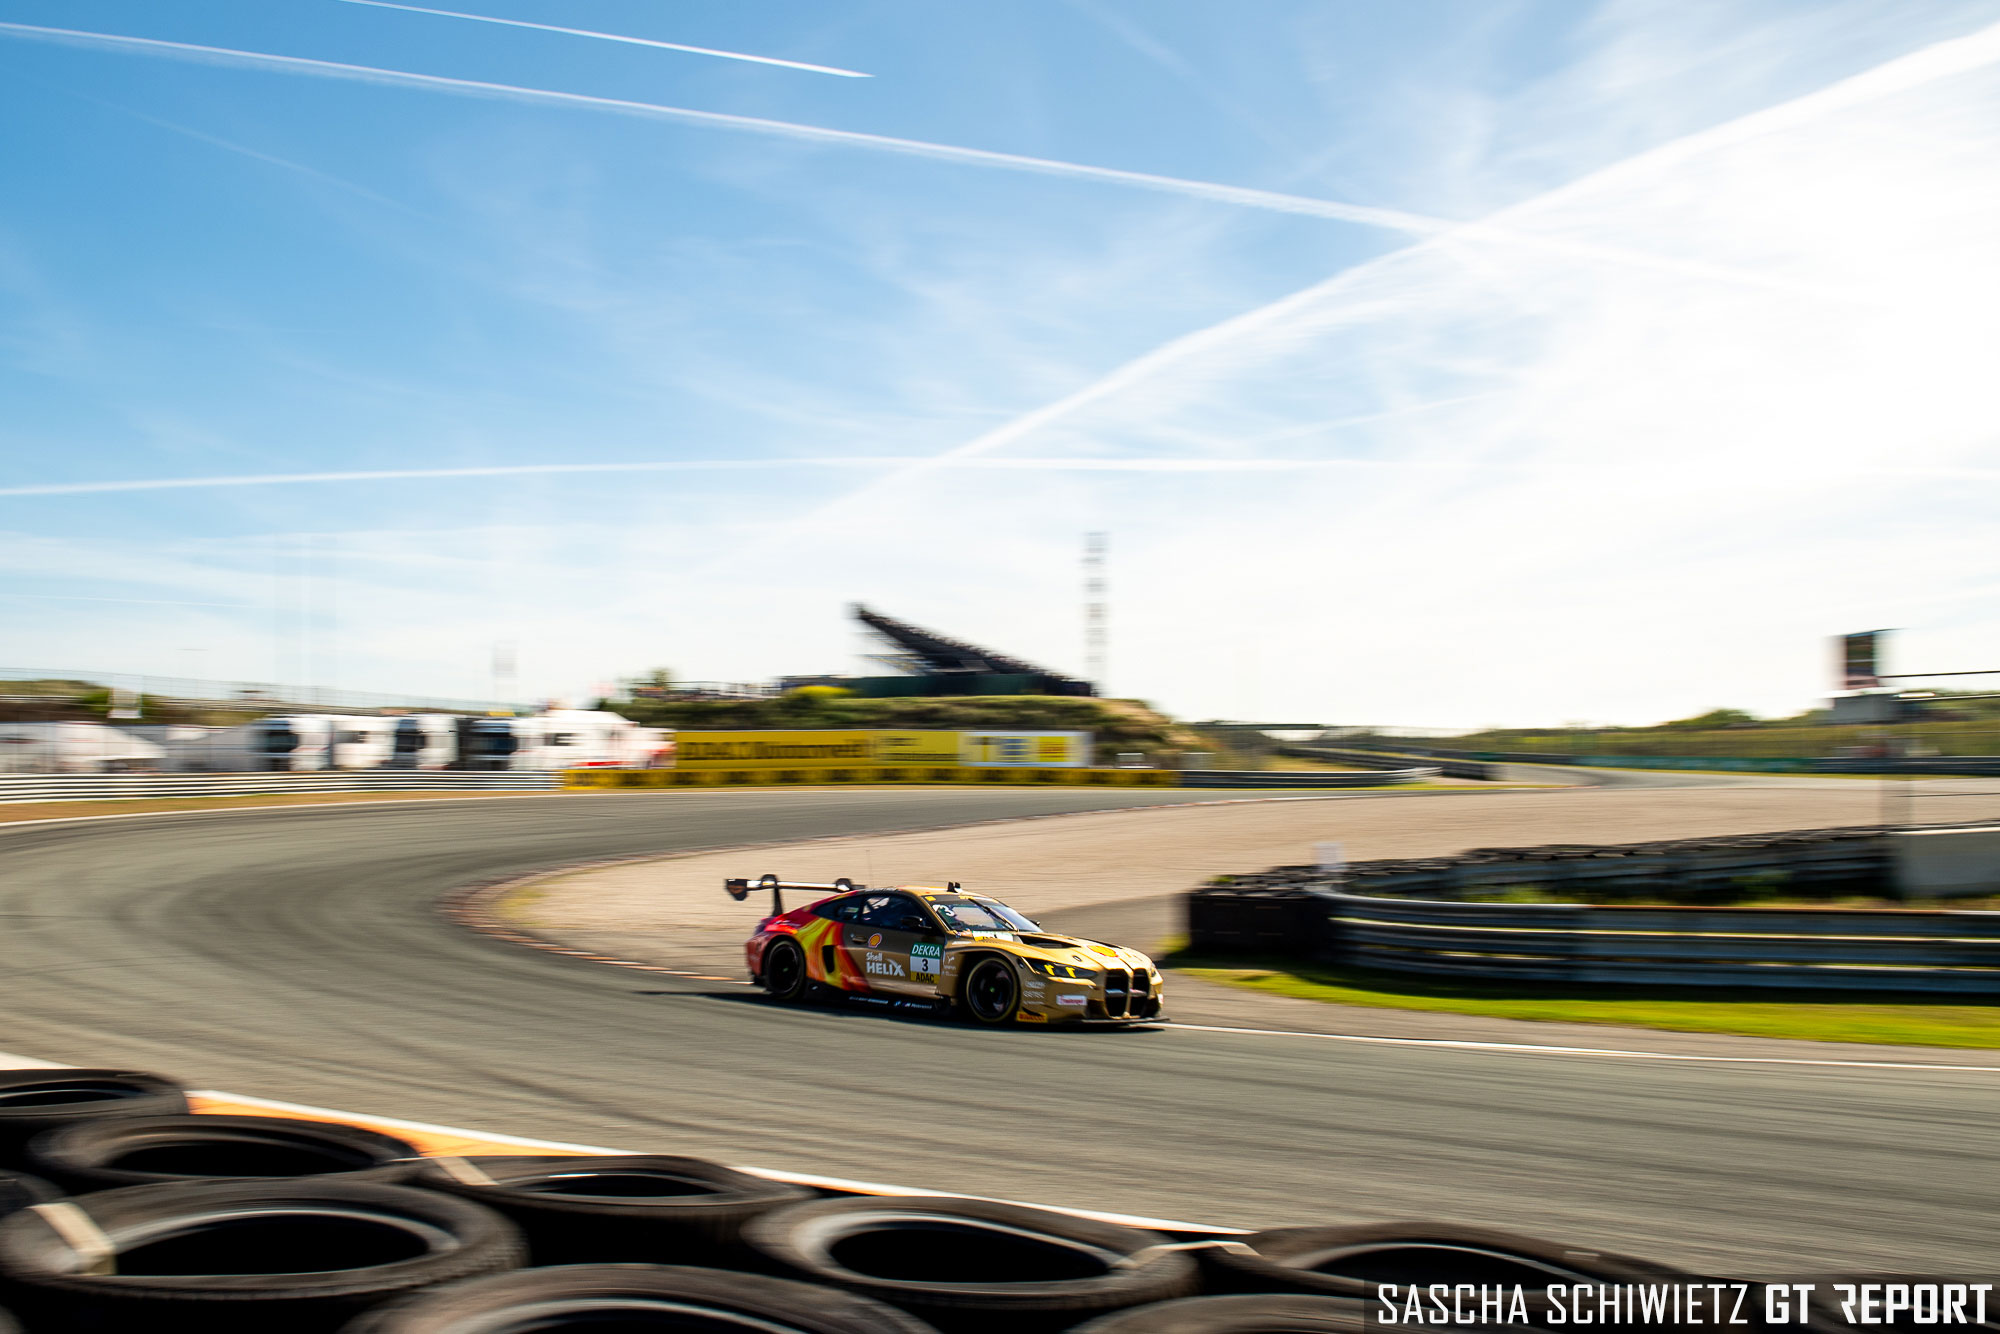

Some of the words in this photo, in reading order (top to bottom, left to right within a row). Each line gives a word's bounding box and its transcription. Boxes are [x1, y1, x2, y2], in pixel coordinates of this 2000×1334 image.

[865, 951, 883, 962] Shell
[911, 944, 941, 957] DEKRA
[866, 958, 906, 977] HELIX
[921, 958, 929, 972] 3
[915, 972, 935, 983] ADAC
